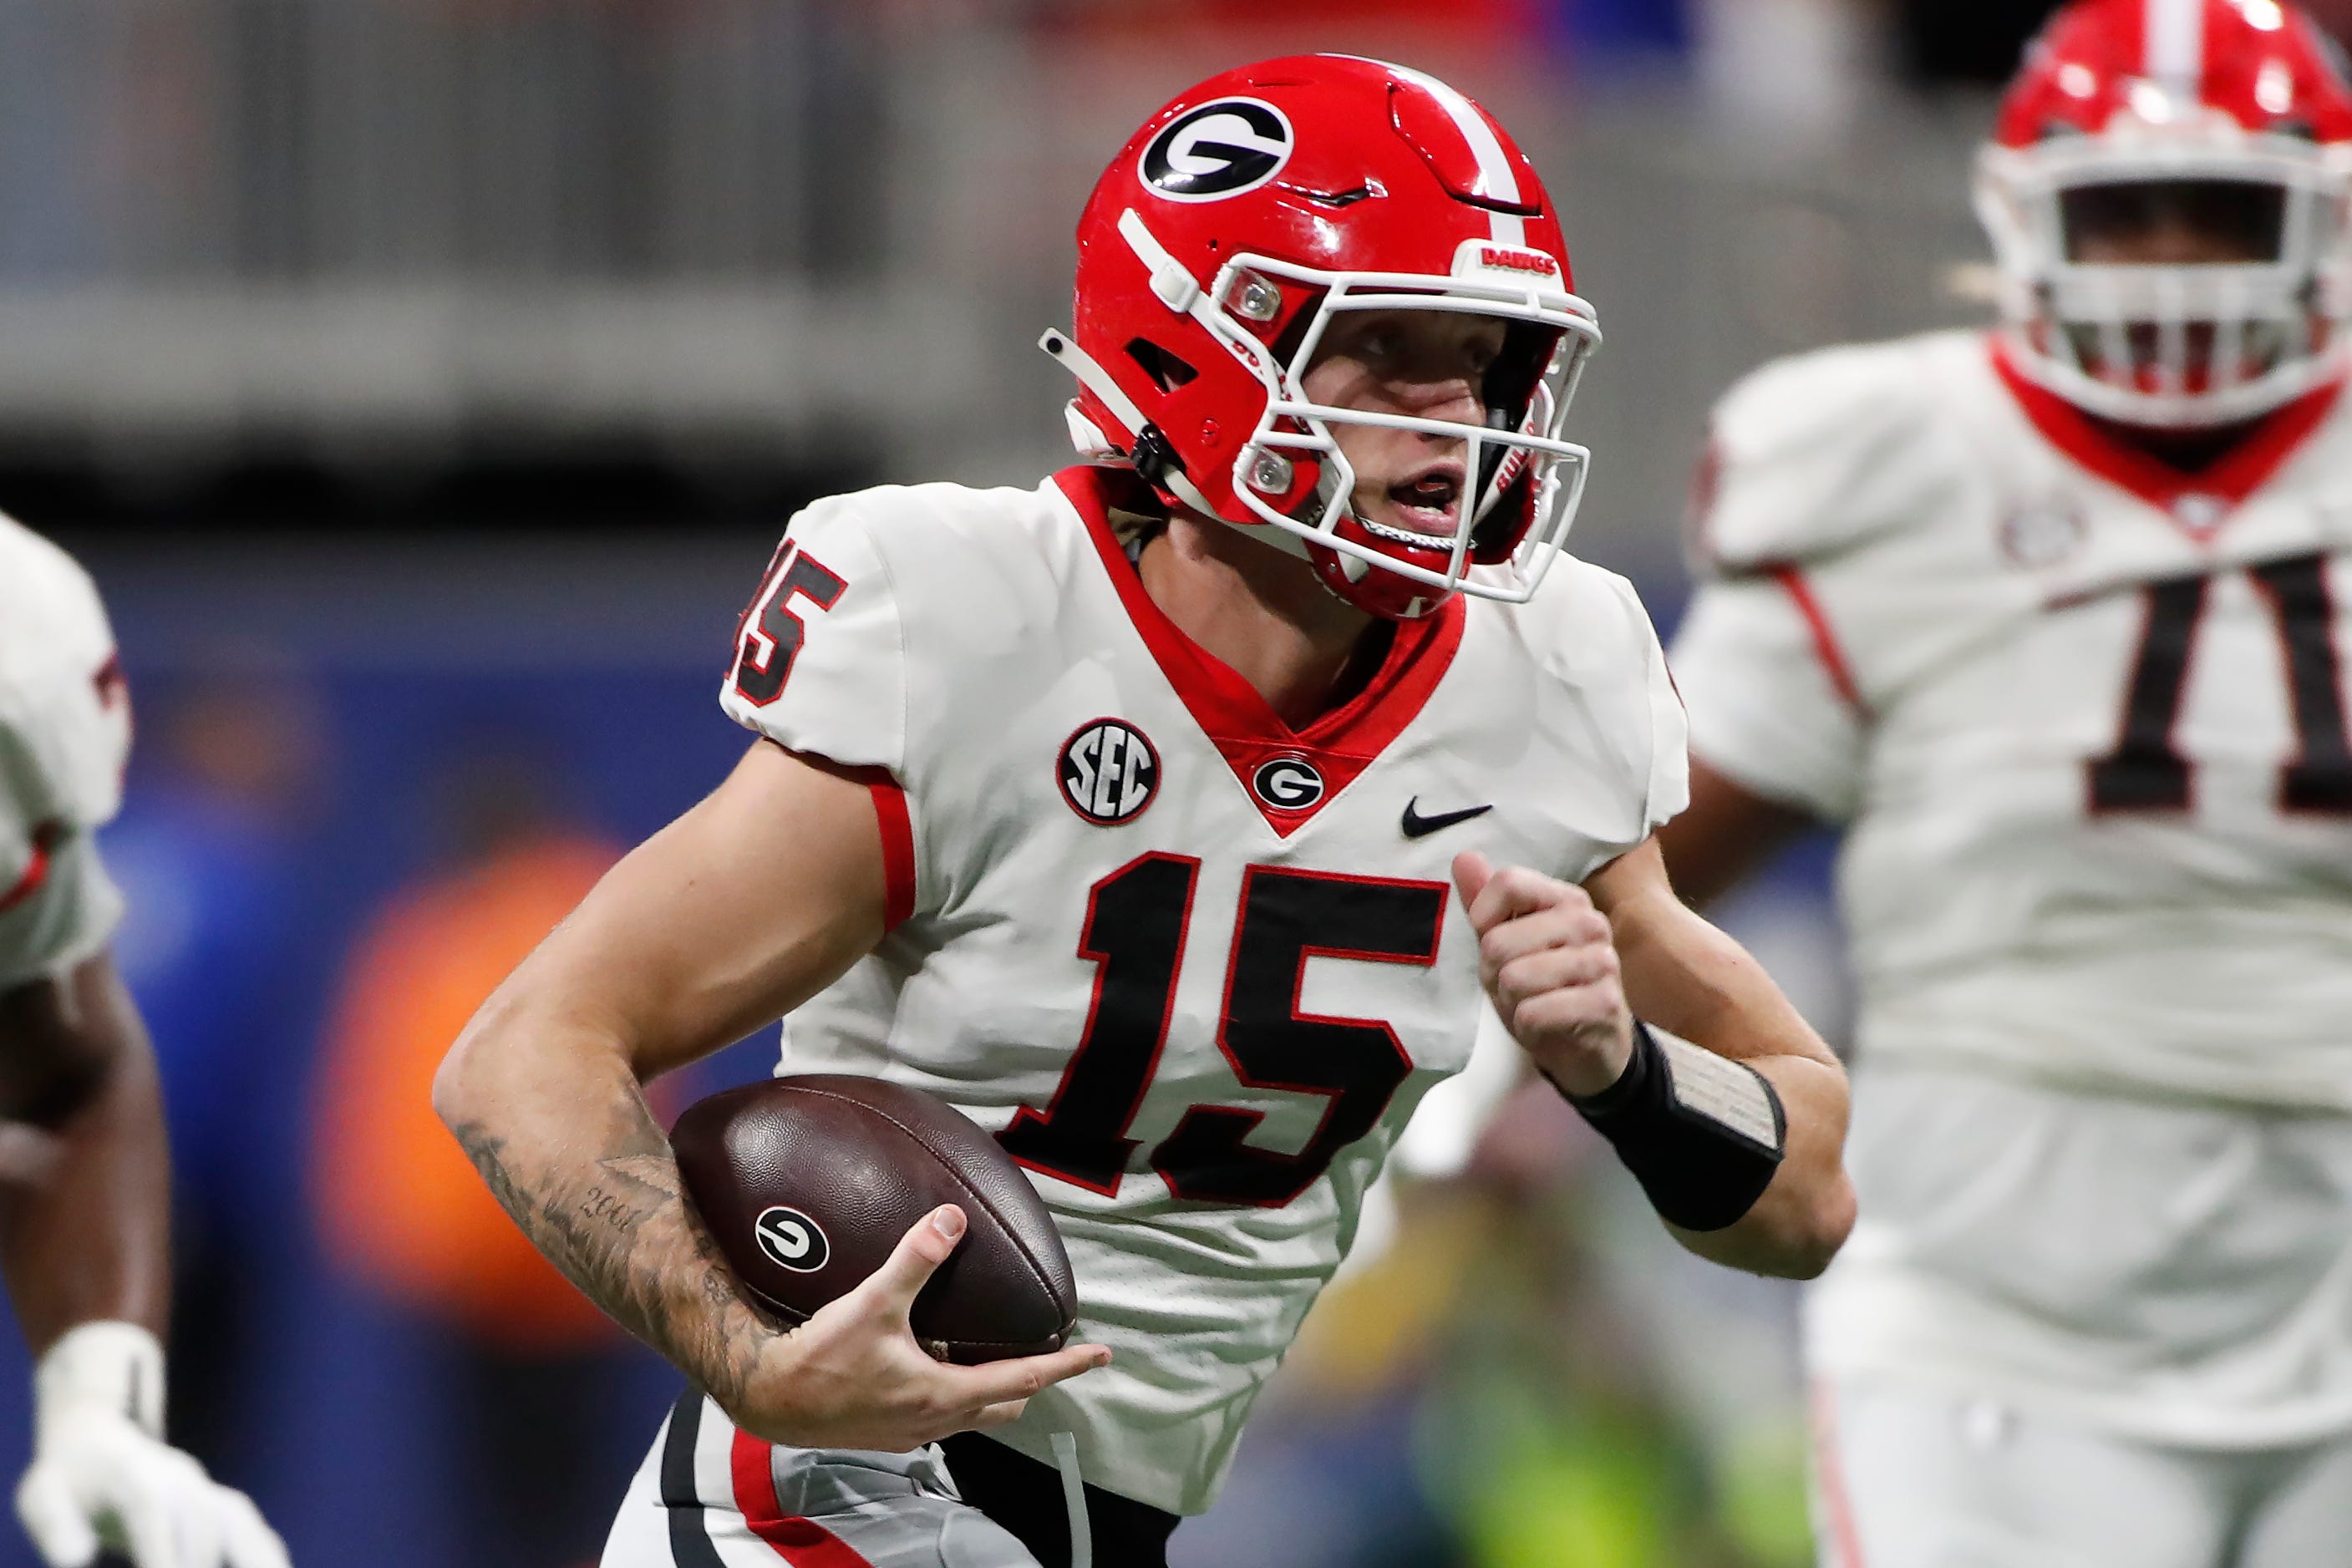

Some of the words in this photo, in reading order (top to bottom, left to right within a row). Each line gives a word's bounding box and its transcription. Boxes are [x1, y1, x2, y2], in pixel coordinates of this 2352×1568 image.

[1146, 102, 1287, 194] G
[1066, 725, 1152, 817] SEC
[1257, 761, 1321, 807] G
[994, 850, 1450, 1208] 15
[758, 1211, 824, 1268] G
